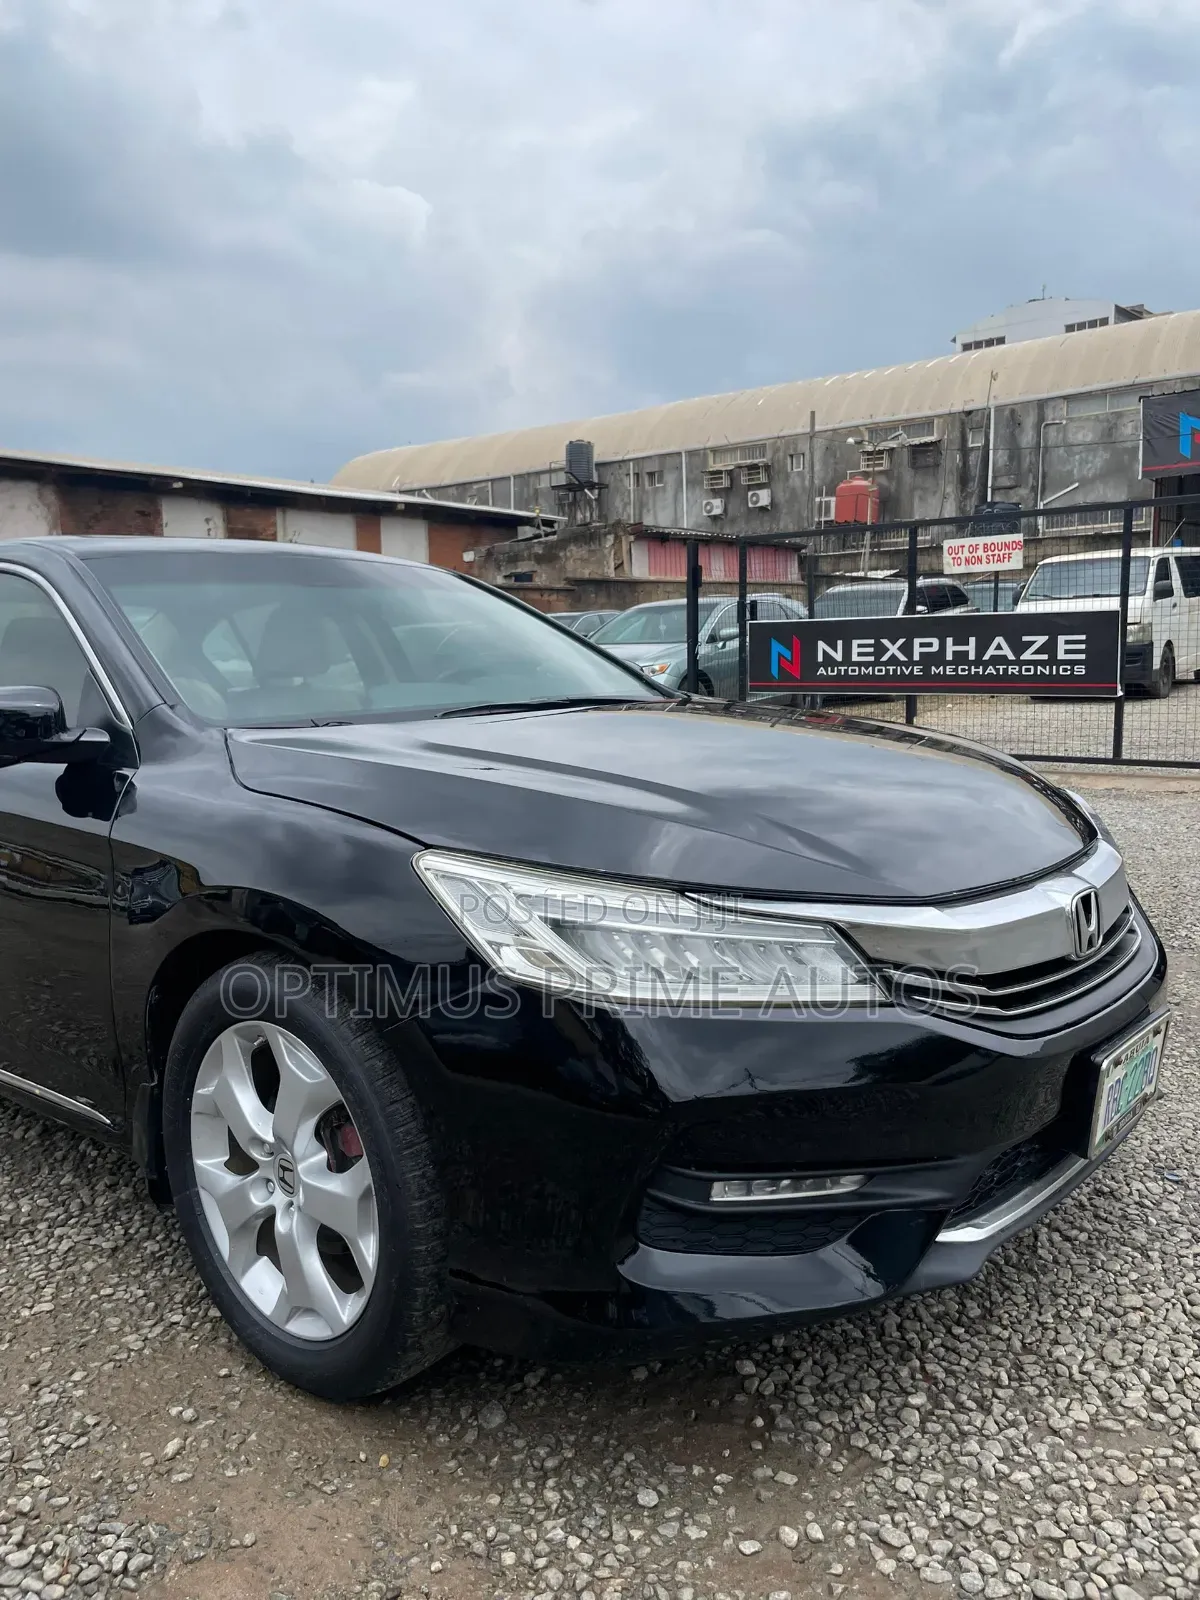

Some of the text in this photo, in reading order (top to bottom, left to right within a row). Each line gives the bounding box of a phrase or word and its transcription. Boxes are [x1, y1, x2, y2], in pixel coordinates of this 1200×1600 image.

[947, 540, 1023, 556] OUT OF BOUNDS
[951, 553, 1013, 567] TO NON STAFF
[817, 634, 1087, 662] NEXPHAZE
[816, 664, 1087, 676] AUTOMOTIVE MECHATRONICS
